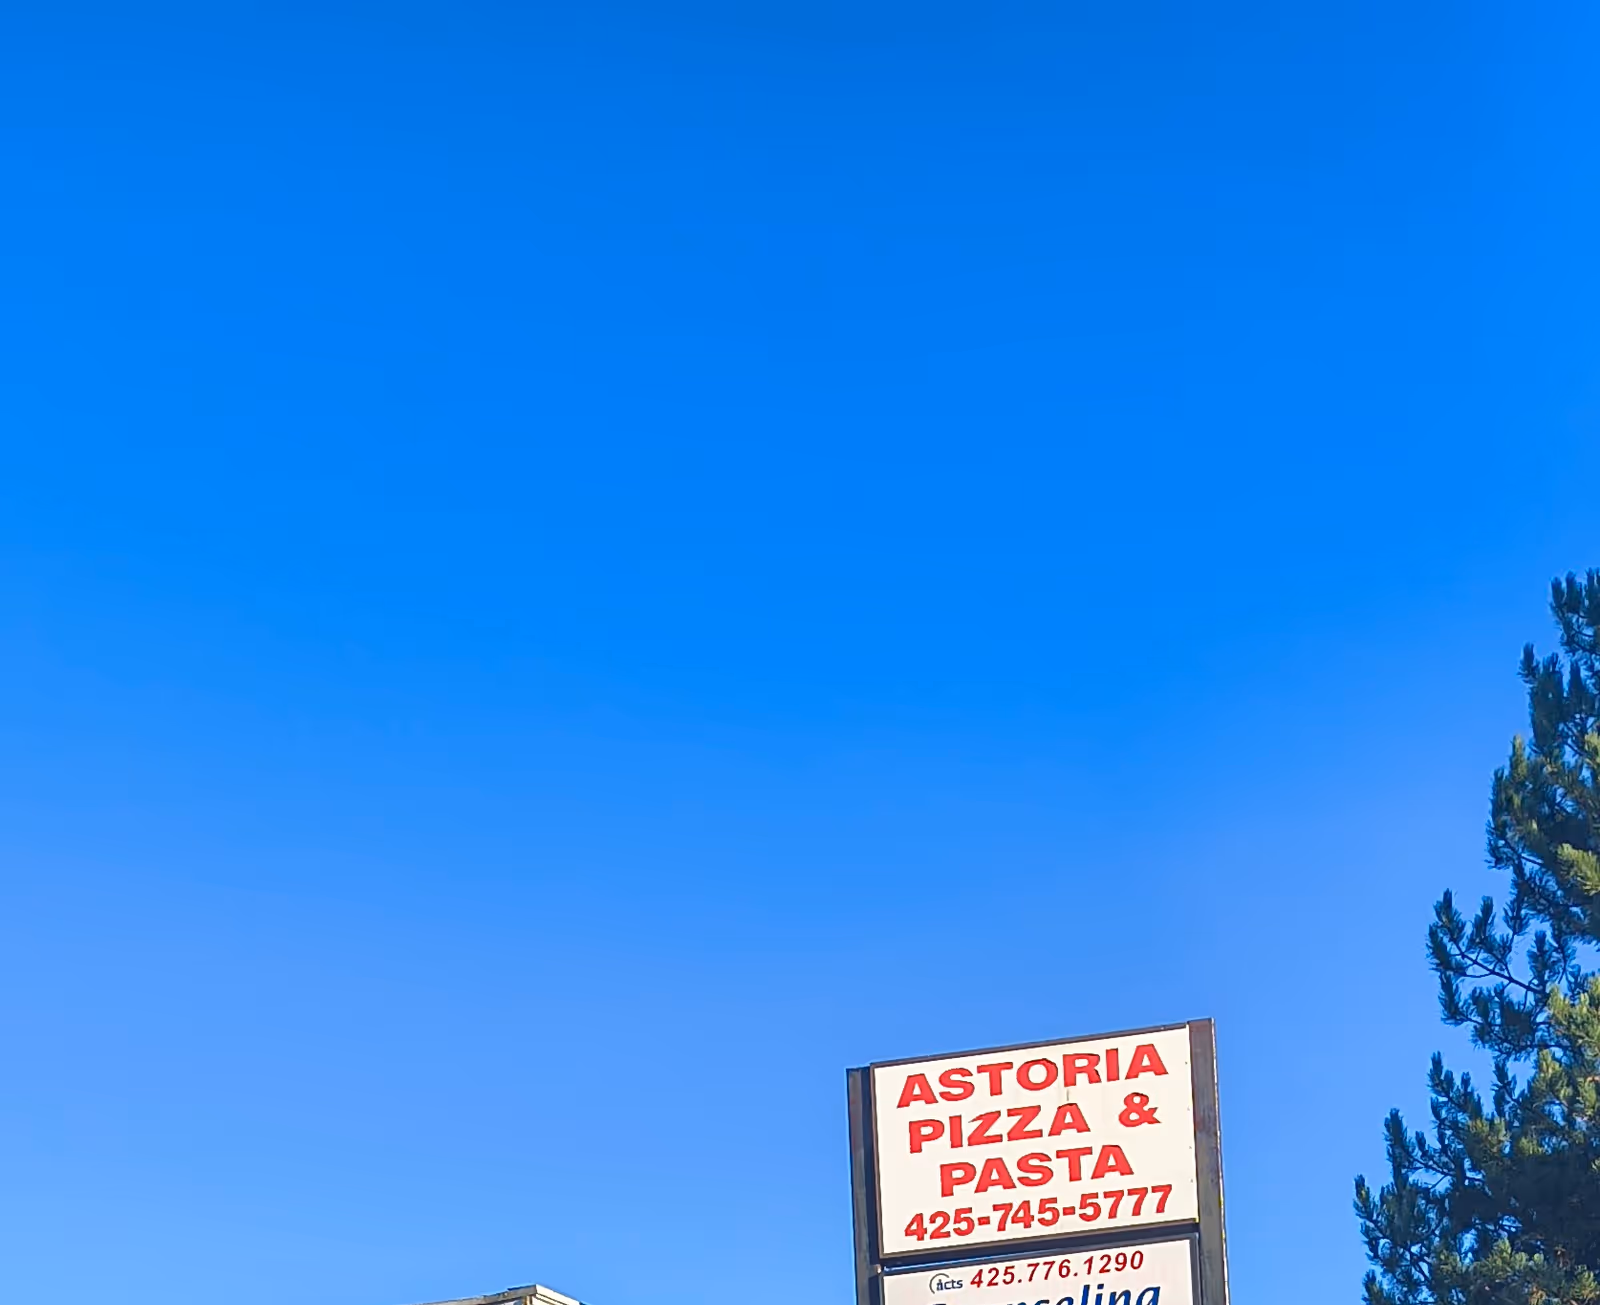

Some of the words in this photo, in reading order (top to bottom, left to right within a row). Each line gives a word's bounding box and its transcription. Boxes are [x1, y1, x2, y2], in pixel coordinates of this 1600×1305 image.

[897, 1044, 1168, 1109] ASTORIA
[908, 1103, 1090, 1153] PIZZA
[1118, 1092, 1161, 1129] &
[940, 1144, 1134, 1198] PASTA
[904, 1184, 1172, 1241] 425-745-5777
[970, 1250, 1144, 1289] 425.776.1290
